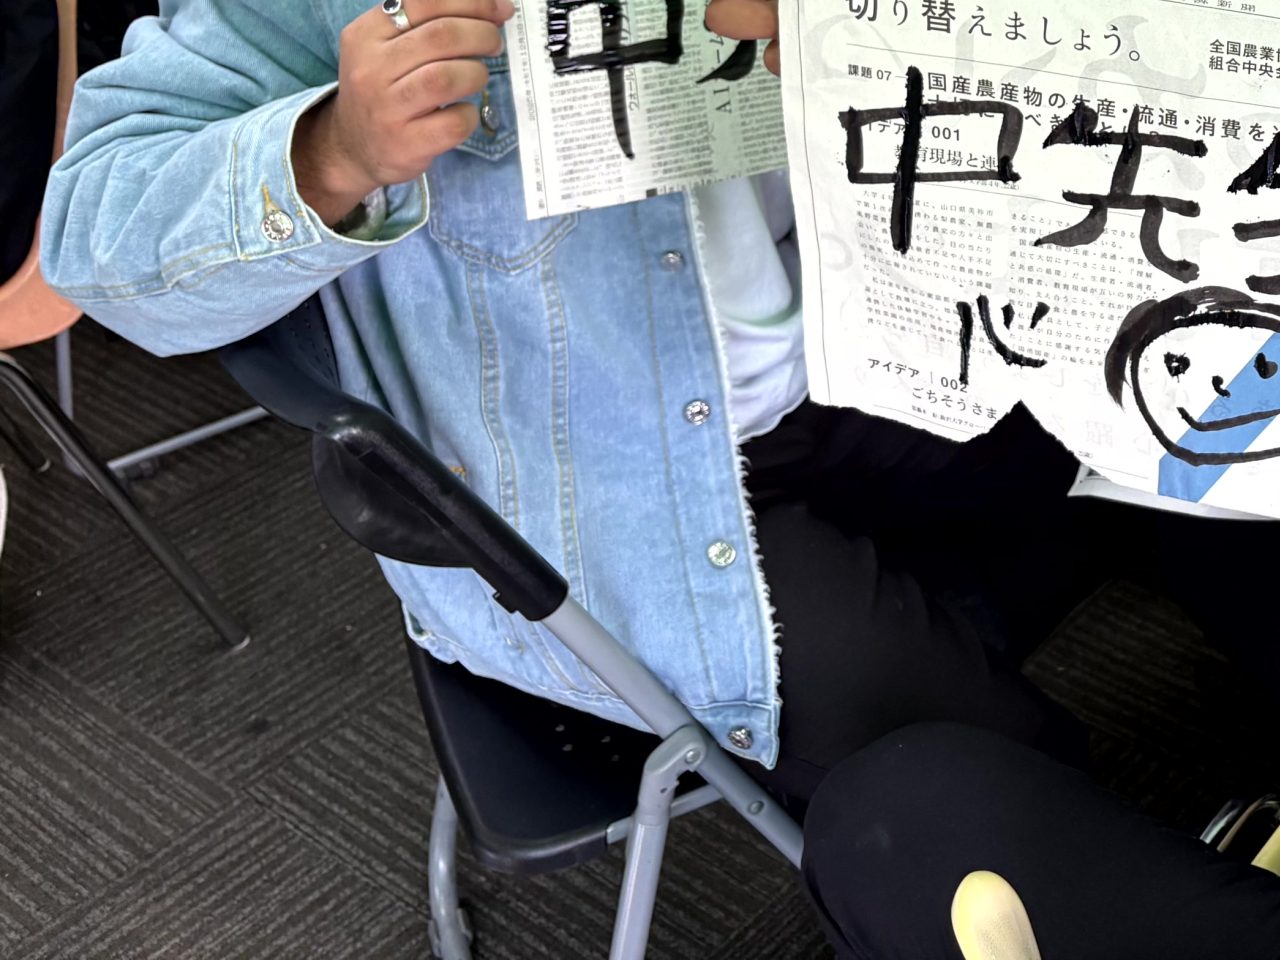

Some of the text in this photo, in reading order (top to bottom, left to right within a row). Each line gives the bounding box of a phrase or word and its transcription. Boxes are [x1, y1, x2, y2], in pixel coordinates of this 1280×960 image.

[848, 64, 892, 81] 課題 07
[931, 126, 961, 141] 001
[867, 358, 920, 378] アイデア
[912, 387, 997, 419] ごちそうさま
